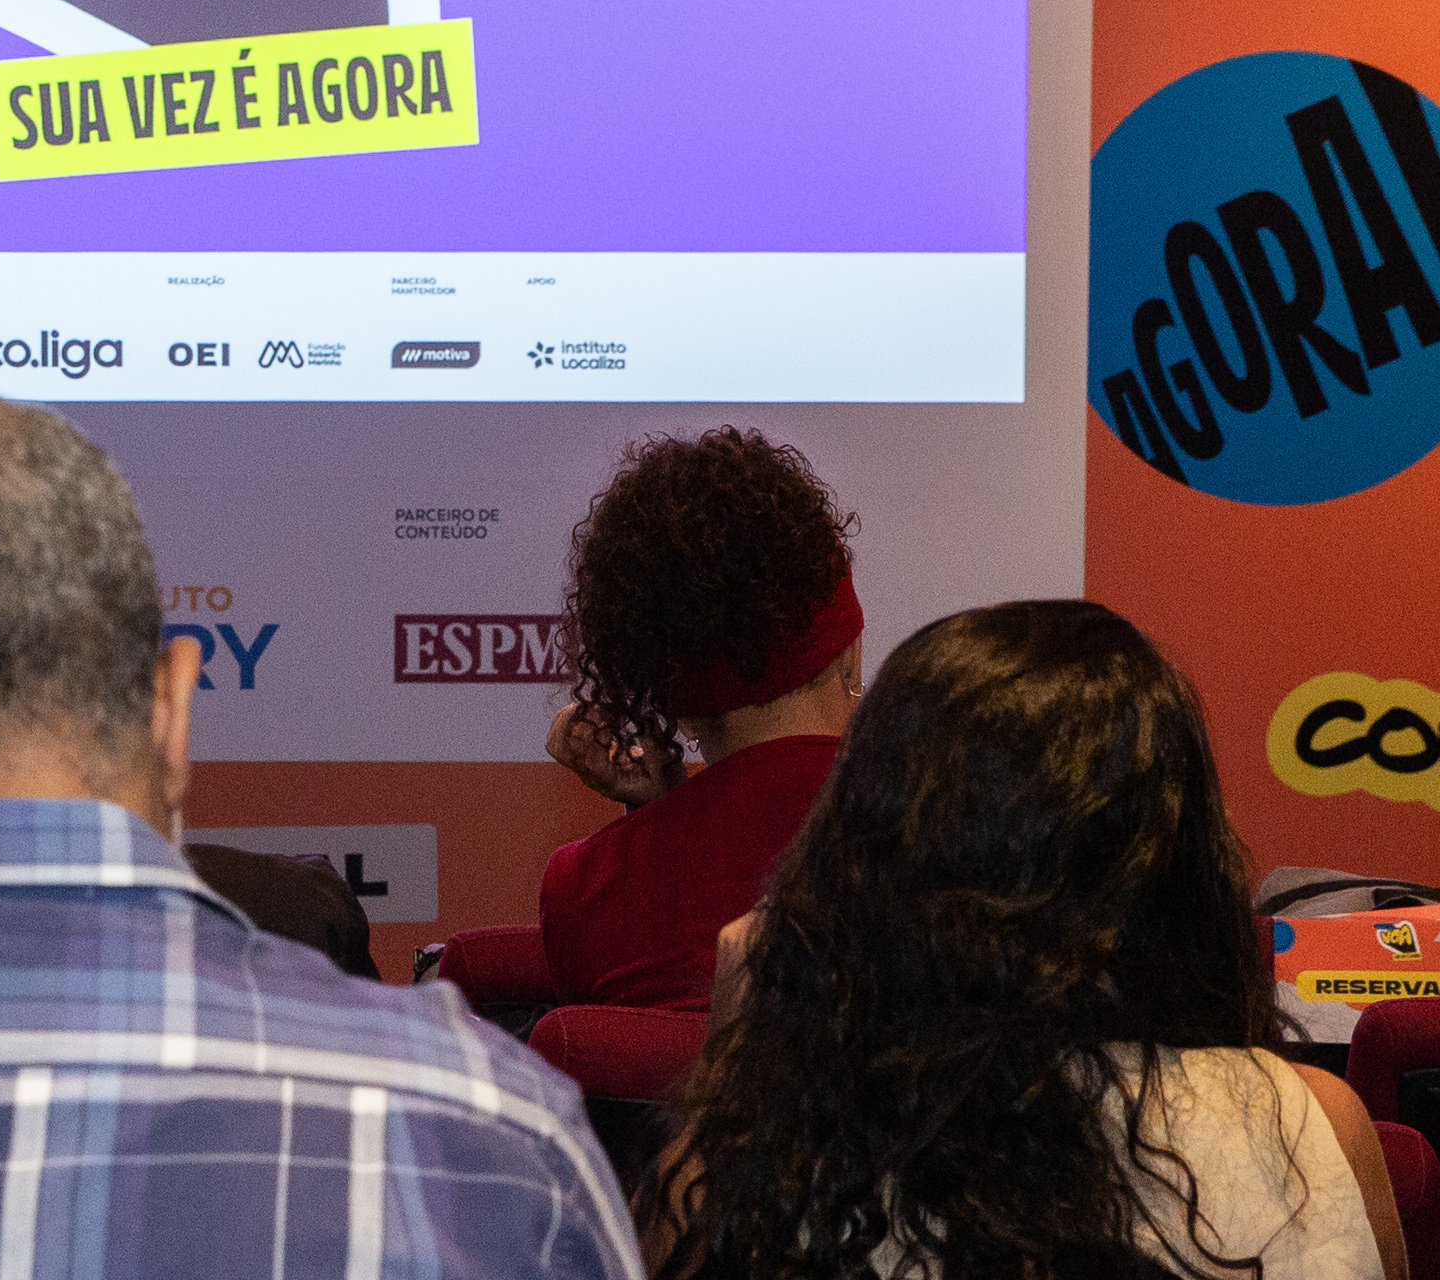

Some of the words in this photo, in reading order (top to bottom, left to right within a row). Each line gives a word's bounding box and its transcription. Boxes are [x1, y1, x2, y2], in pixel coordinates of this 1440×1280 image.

[8, 80, 112, 150] SUA
[121, 68, 218, 140] VEZ
[232, 48, 261, 130] É
[277, 48, 453, 127] AGORA
[167, 342, 231, 368] OEI
[423, 348, 472, 362] motiva
[561, 340, 627, 354] instituto
[395, 508, 475, 523] PARCEIRO
[478, 508, 500, 522] DE
[395, 522, 488, 540] CONTEÚDO
[401, 622, 570, 675] ESPM
